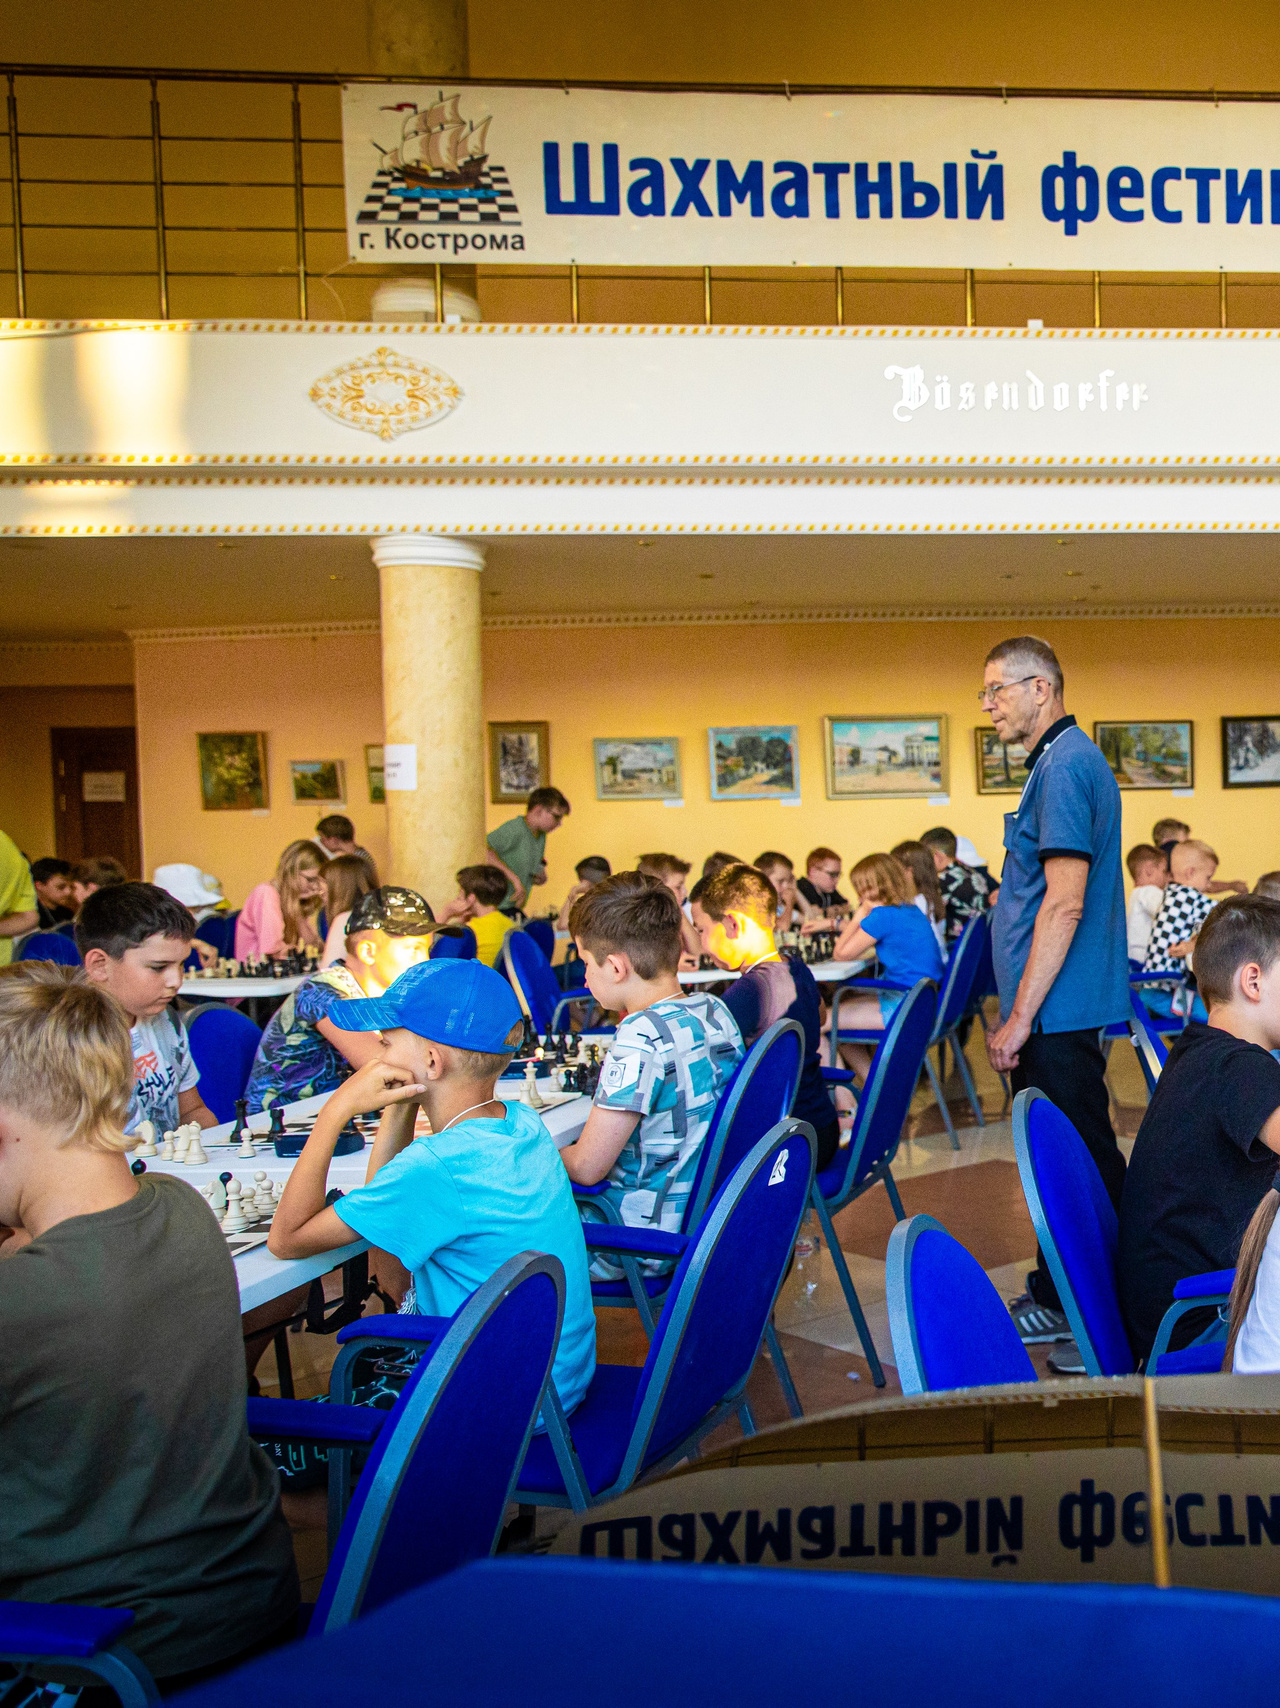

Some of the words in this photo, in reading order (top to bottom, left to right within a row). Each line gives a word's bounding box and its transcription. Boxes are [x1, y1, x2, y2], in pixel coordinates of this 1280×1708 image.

[542, 140, 1004, 221] Шахматный
[358, 232, 375, 250] г.
[384, 227, 526, 256] Кострома
[883, 364, 1149, 423] Bösendorfer
